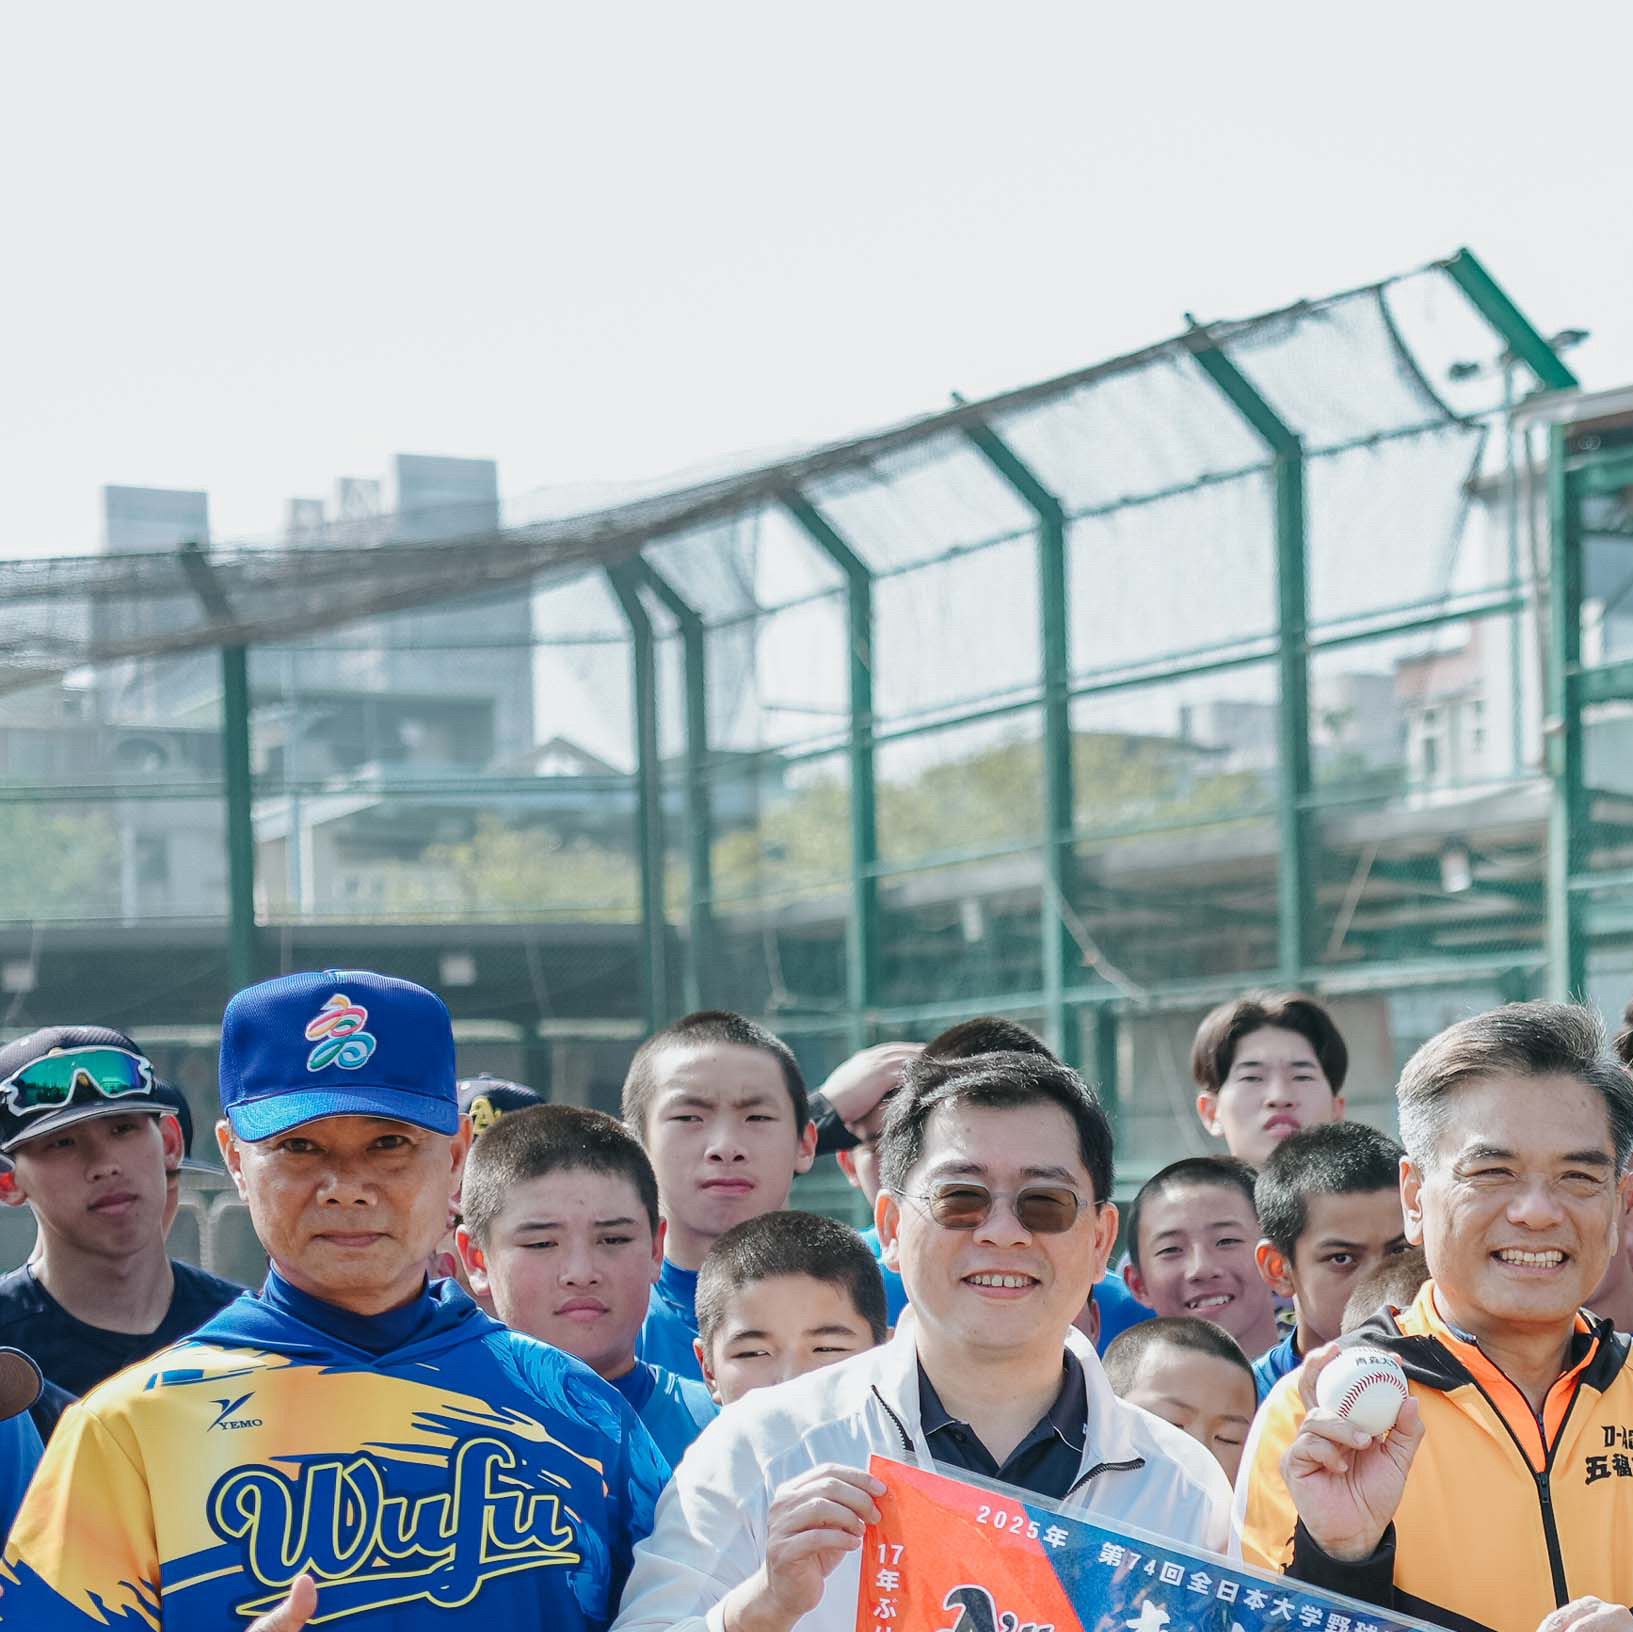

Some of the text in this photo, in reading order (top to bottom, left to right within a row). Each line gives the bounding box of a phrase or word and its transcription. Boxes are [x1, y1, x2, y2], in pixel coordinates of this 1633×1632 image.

[219, 1417, 263, 1431] YEMO
[208, 1433, 582, 1612] Wufu
[976, 1505, 1069, 1548] 2025年
